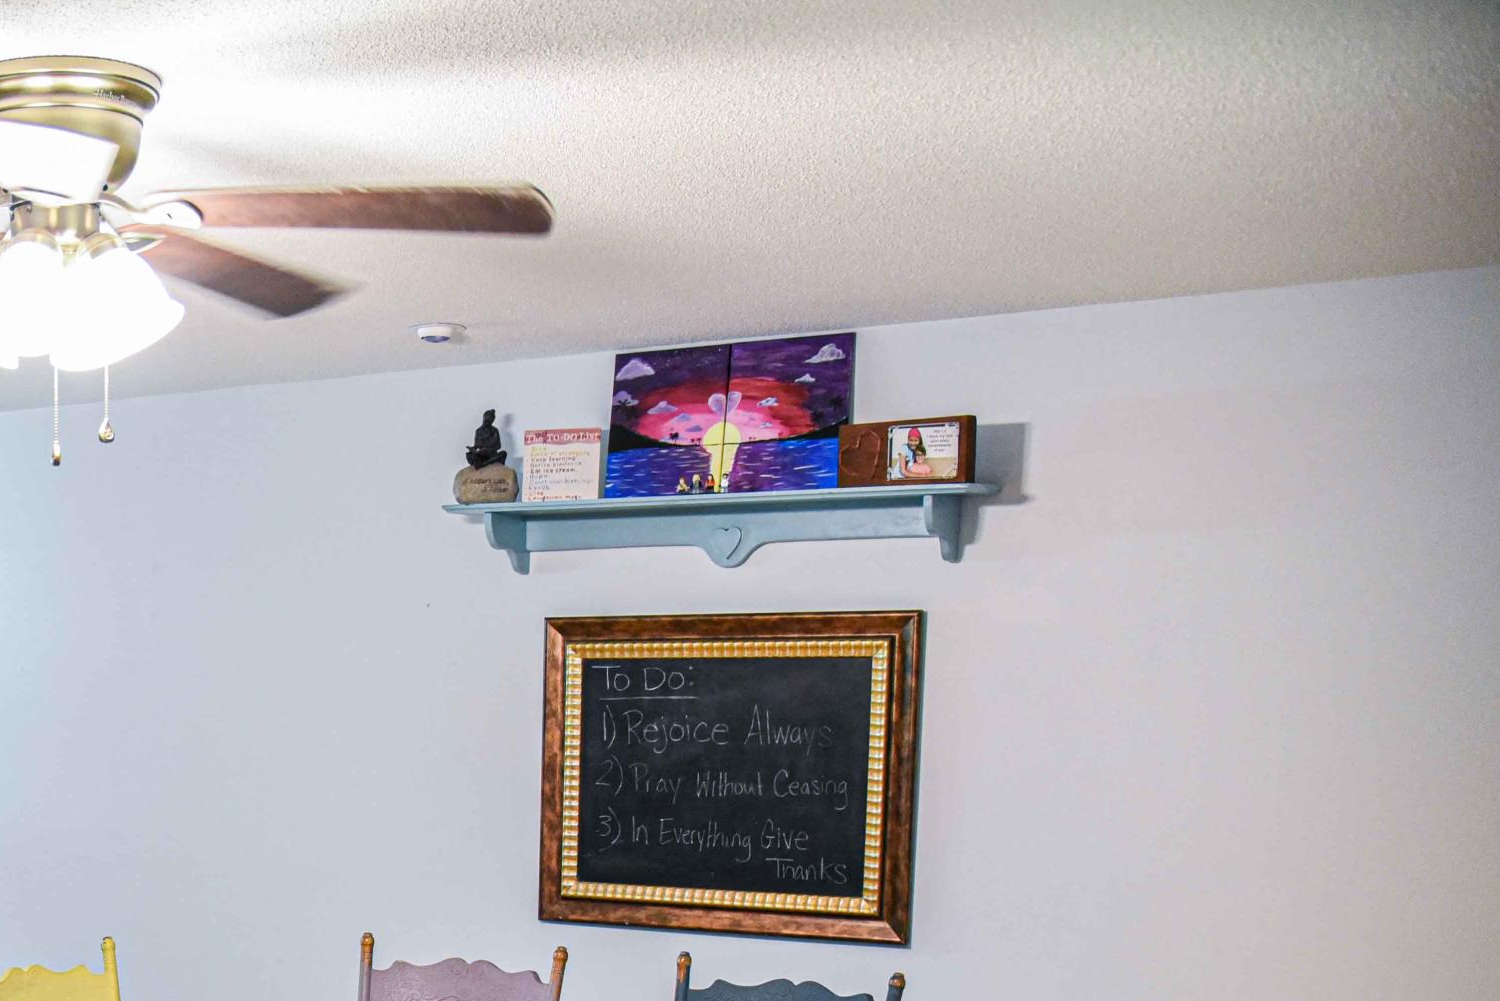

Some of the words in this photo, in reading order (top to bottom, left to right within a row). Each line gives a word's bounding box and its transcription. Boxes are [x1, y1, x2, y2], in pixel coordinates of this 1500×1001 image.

[526, 433, 544, 443] The
[591, 665, 631, 692] To
[643, 665, 694, 692] Do:
[602, 704, 617, 750] 1)
[622, 708, 730, 755] Rejoice
[743, 703, 833, 758] Always
[595, 754, 624, 798] 2)
[628, 762, 682, 805] Pray
[696, 770, 763, 798] Without
[772, 768, 849, 811] Ceasing
[596, 805, 622, 846] 3)
[631, 815, 649, 846] In
[659, 817, 751, 863] Everything
[760, 818, 810, 851] Give
[765, 856, 848, 885] Thanks
